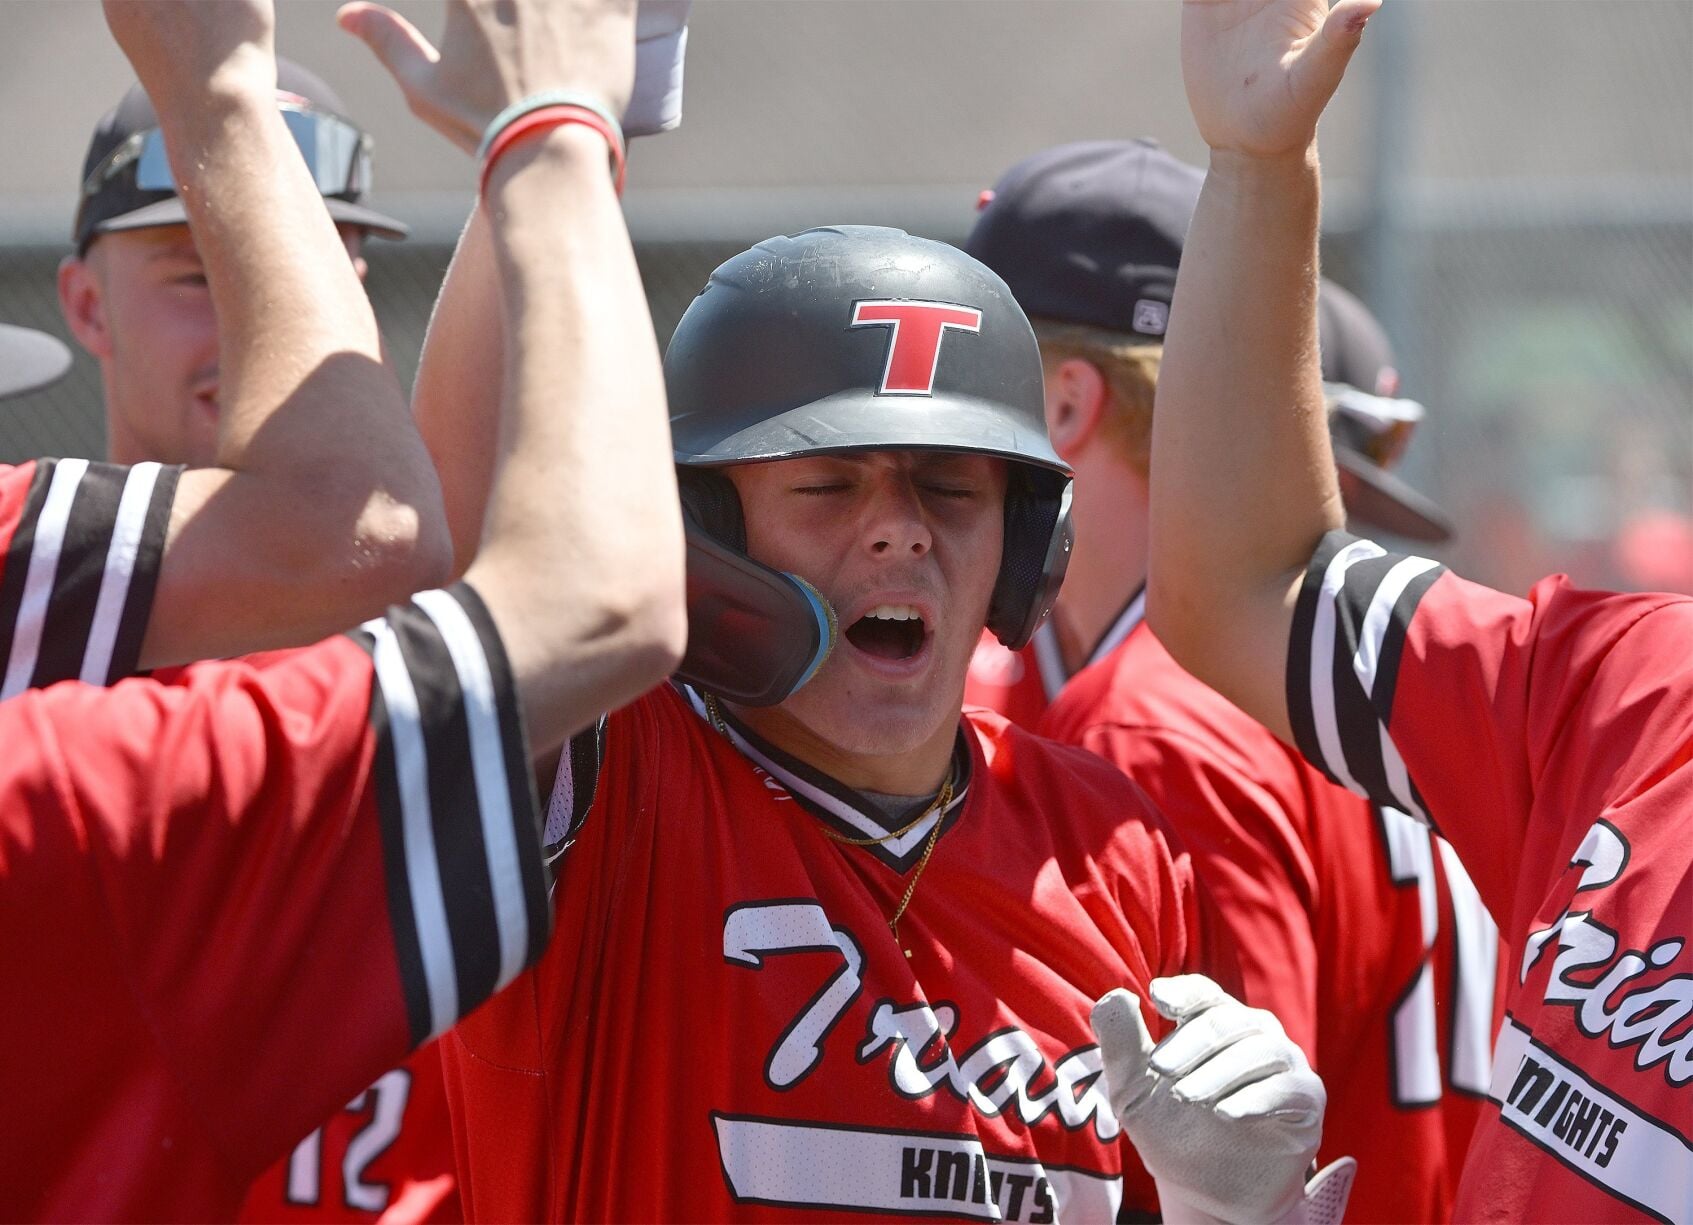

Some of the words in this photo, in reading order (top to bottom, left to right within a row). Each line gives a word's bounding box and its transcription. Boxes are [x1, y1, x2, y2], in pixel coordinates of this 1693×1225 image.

[850, 298, 983, 398] T
[1505, 1053, 1628, 1169] NIGHTS
[900, 1146, 1055, 1225] KNITS
